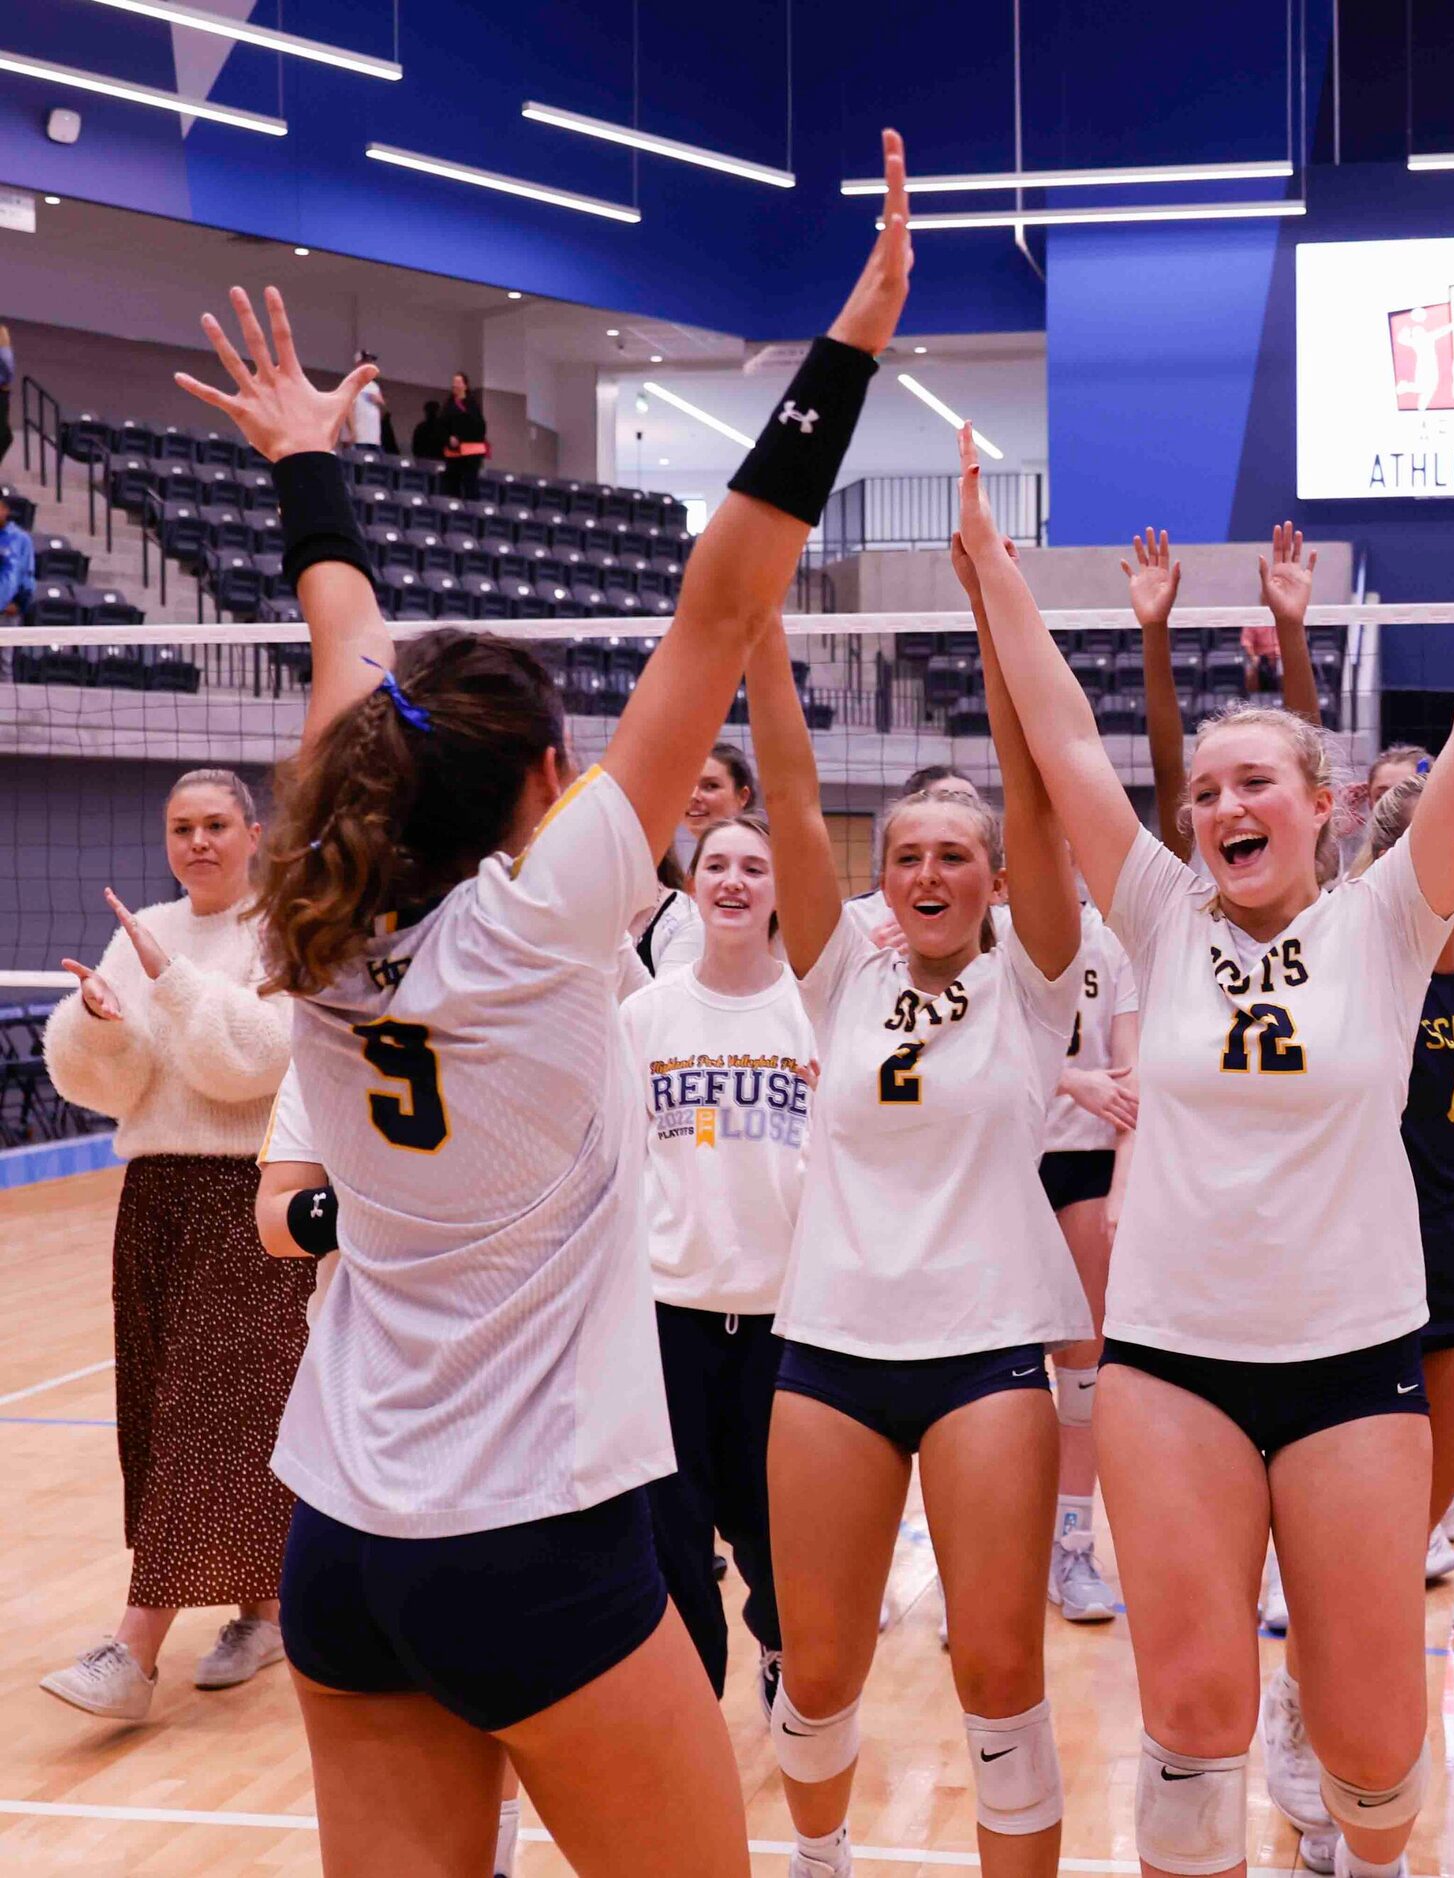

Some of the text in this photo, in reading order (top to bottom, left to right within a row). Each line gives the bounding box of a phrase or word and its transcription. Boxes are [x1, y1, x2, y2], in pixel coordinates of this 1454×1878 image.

[1219, 1002, 1309, 1076] 12
[352, 1014, 453, 1156] 9
[650, 1069, 809, 1117] REFUSE
[878, 1039, 924, 1106] 2
[656, 1109, 695, 1130] 2022
[719, 1107, 805, 1148] LOSE
